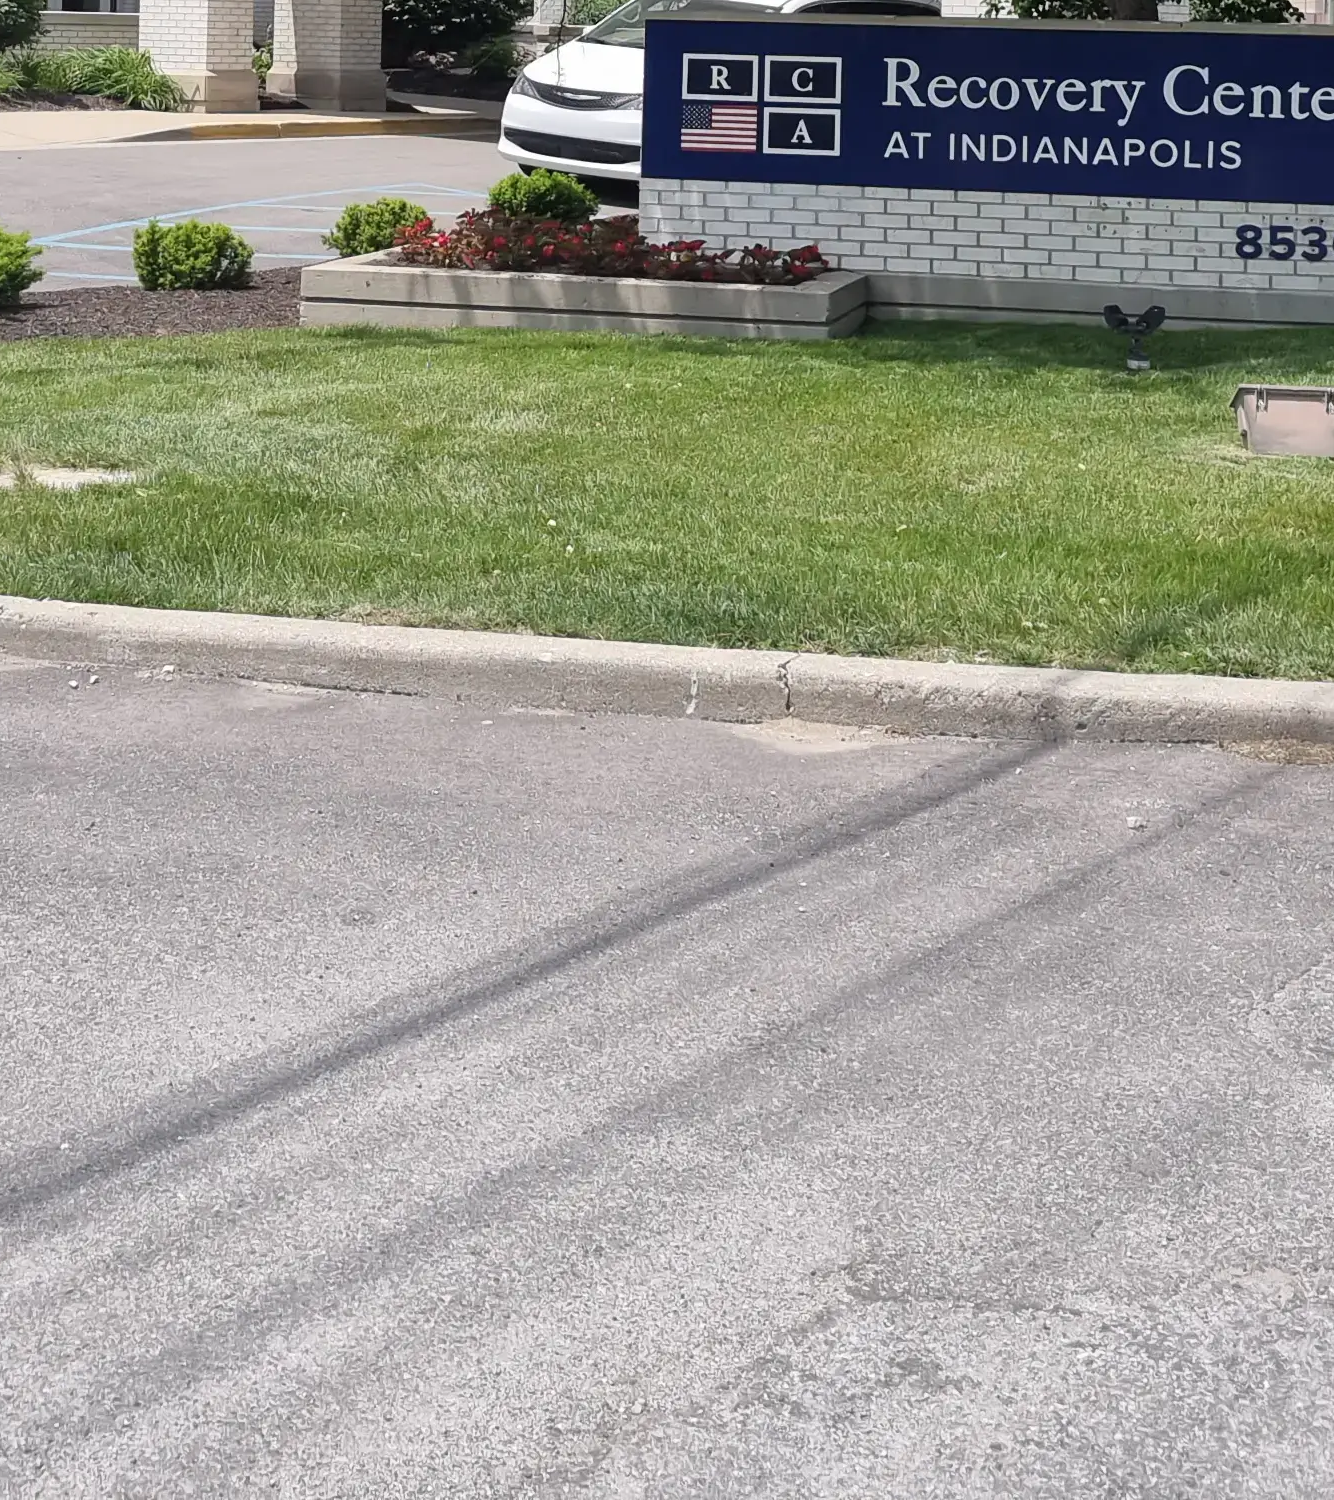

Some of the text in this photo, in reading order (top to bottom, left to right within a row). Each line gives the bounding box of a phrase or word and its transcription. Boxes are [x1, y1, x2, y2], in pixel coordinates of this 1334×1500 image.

[709, 65, 814, 92] R C
[881, 57, 1146, 127] Recovery
[790, 118, 813, 144] A
[883, 131, 1242, 170] AT INDIANAPOLIS
